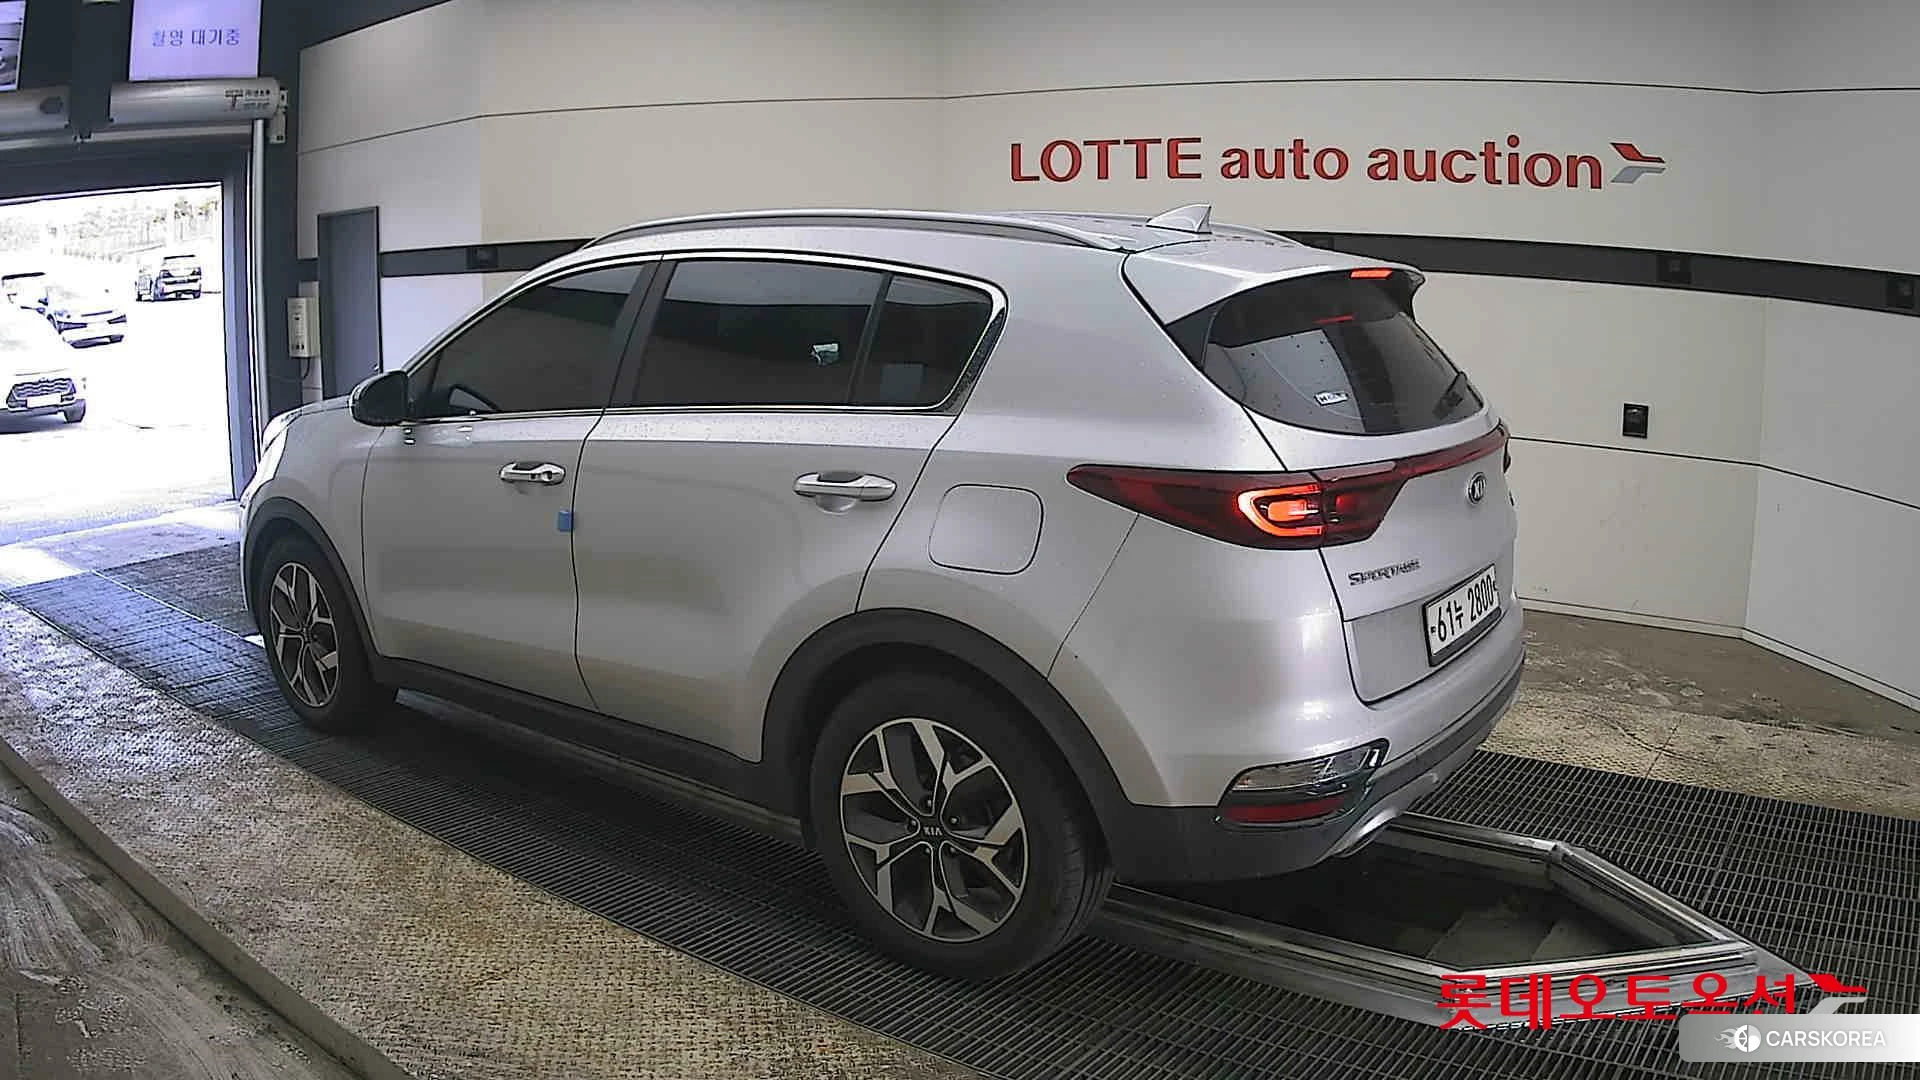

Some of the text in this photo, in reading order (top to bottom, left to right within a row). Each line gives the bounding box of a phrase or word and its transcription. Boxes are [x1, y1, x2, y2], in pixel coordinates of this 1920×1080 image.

[191, 28, 240, 46] 대기중
[1011, 134, 1603, 190] LOTTE auto auction
[1437, 574, 1494, 642] 61누 2800
[923, 826, 943, 836] KIA
